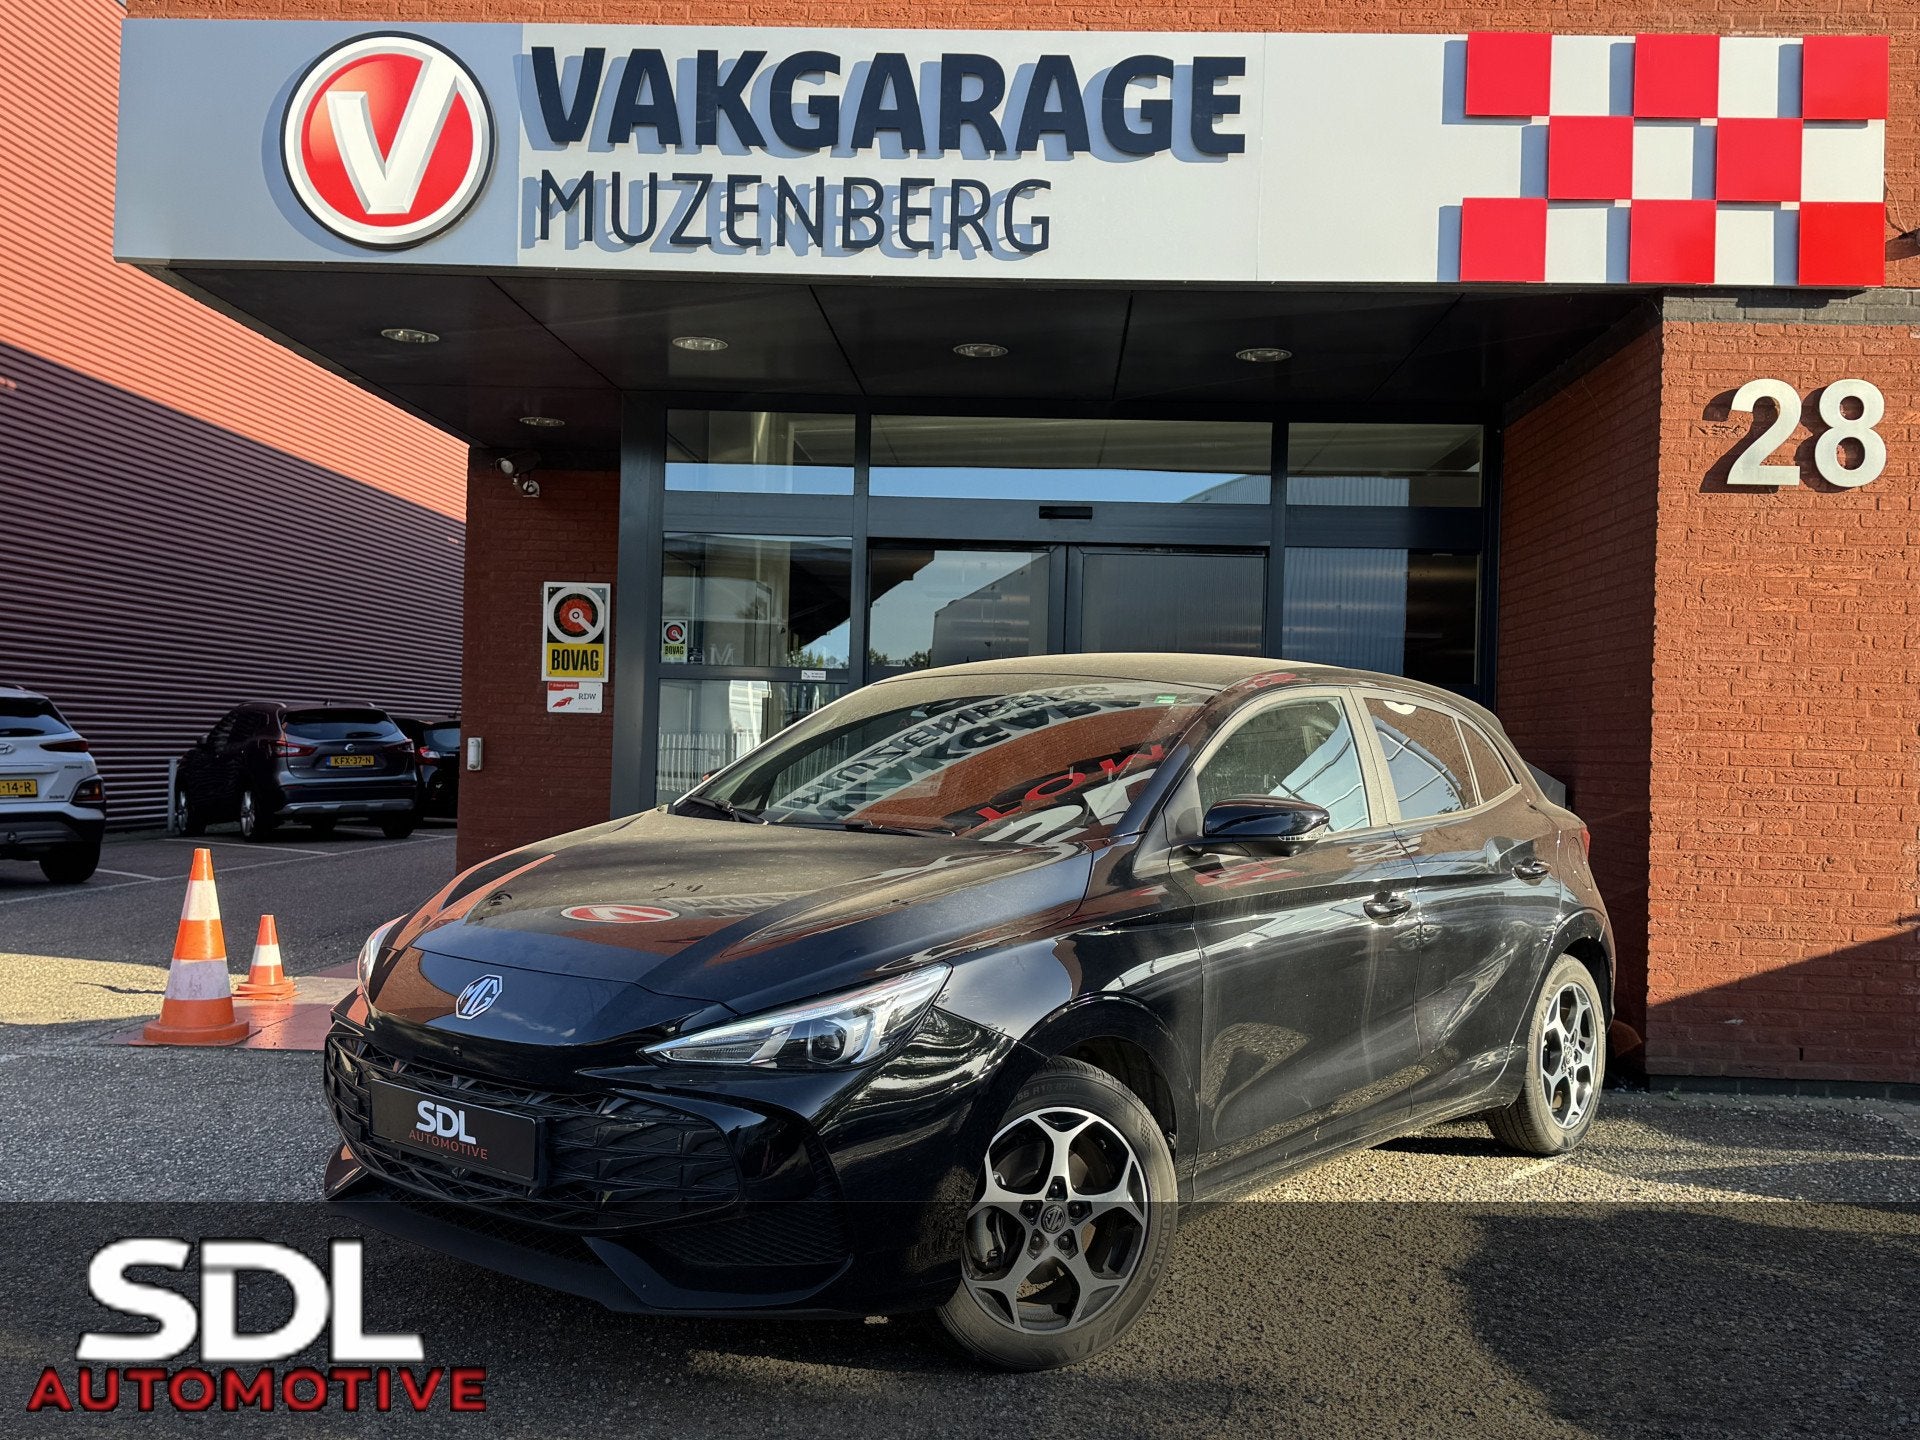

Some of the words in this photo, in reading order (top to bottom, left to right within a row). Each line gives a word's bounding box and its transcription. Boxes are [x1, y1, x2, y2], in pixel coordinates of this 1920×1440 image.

[532, 47, 1246, 153] VAKGARAGE
[540, 169, 1051, 253] MUZENBERG
[1726, 378, 1888, 489] 28
[552, 649, 599, 671] BOVAG
[664, 645, 684, 655] BOVAG
[578, 692, 597, 700] RDW
[334, 756, 372, 765] KFX-37-N
[0, 782, 31, 793] -14-R
[460, 978, 498, 1014] MG
[416, 1100, 477, 1145] SDL
[408, 1129, 488, 1160] AUTOMOTIVE
[1151, 1199, 1173, 1280] KUMHO
